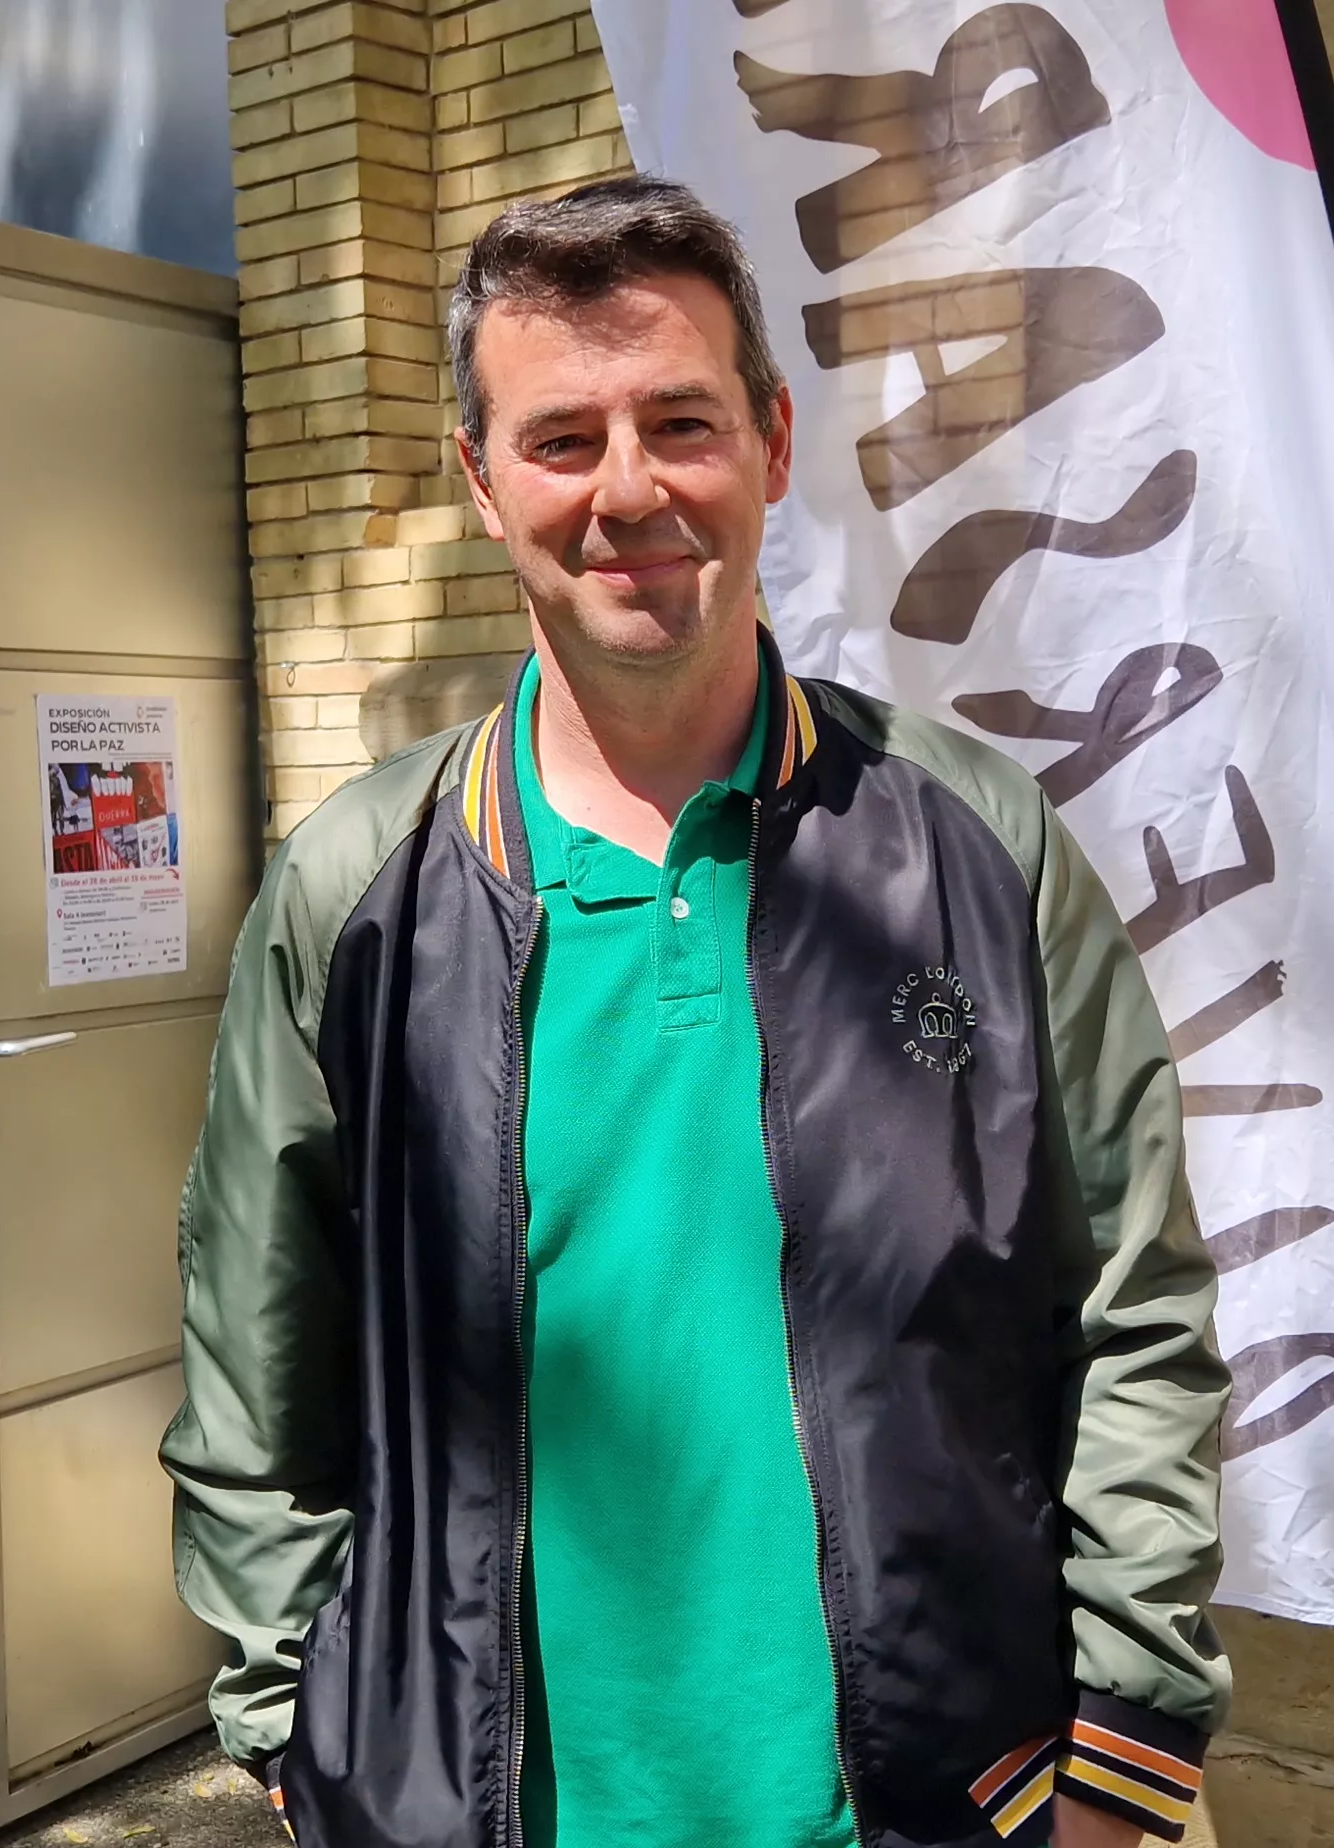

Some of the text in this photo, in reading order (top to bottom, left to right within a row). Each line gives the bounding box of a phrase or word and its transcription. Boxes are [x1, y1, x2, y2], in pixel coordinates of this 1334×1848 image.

[48, 707, 110, 718] EXPOSICIÓN
[49, 720, 161, 734] DISEÑO ACTIVISTA
[51, 739, 125, 752] POR LA PAZ
[890, 973, 920, 1023] MERC
[902, 1040, 942, 1073] EST.
